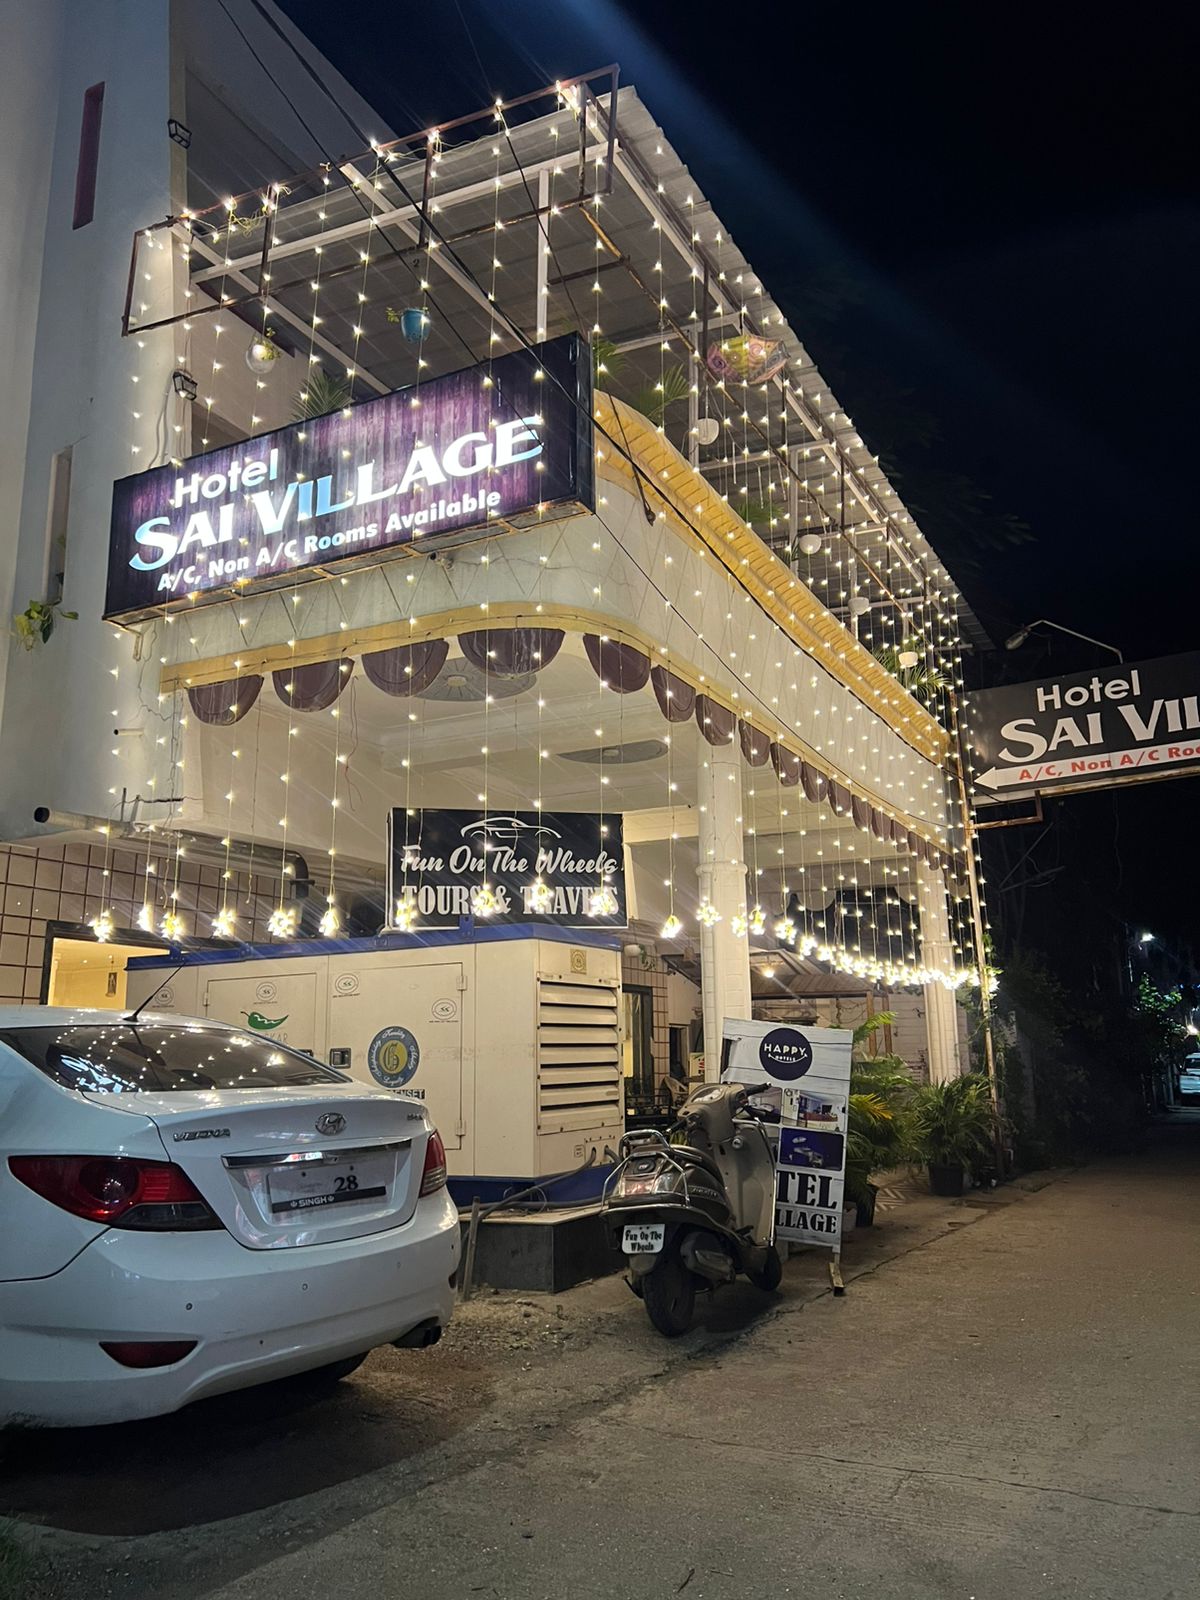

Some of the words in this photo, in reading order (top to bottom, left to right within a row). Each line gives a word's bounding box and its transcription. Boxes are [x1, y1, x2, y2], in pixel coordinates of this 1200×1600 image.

[129, 500, 235, 572] SAI
[250, 415, 544, 535] VILLAGE
[174, 448, 279, 508] Hotel
[157, 567, 202, 592] A/C,
[208, 556, 249, 578] Non
[255, 540, 297, 567] A/C
[304, 523, 378, 554] Rooms
[385, 489, 501, 534] Available
[1036, 669, 1141, 712] Hotel
[998, 712, 1104, 763] SAI
[1117, 695, 1200, 742] VIL
[1018, 765, 1063, 782] A/C,
[1071, 759, 1112, 773] Non
[1120, 749, 1160, 767] A/C
[401, 844, 445, 873] Fun
[449, 845, 486, 874] On
[484, 845, 528, 874] The
[535, 847, 618, 874] Wheels
[494, 885, 511, 914] &
[520, 886, 619, 915] TAVES
[763, 1042, 806, 1056] HAPPY
[334, 1174, 359, 1192] 28
[298, 1196, 328, 1208] SINGH
[625, 1229, 638, 1241] Fun
[640, 1231, 649, 1241] On
[650, 1230, 662, 1241] The
